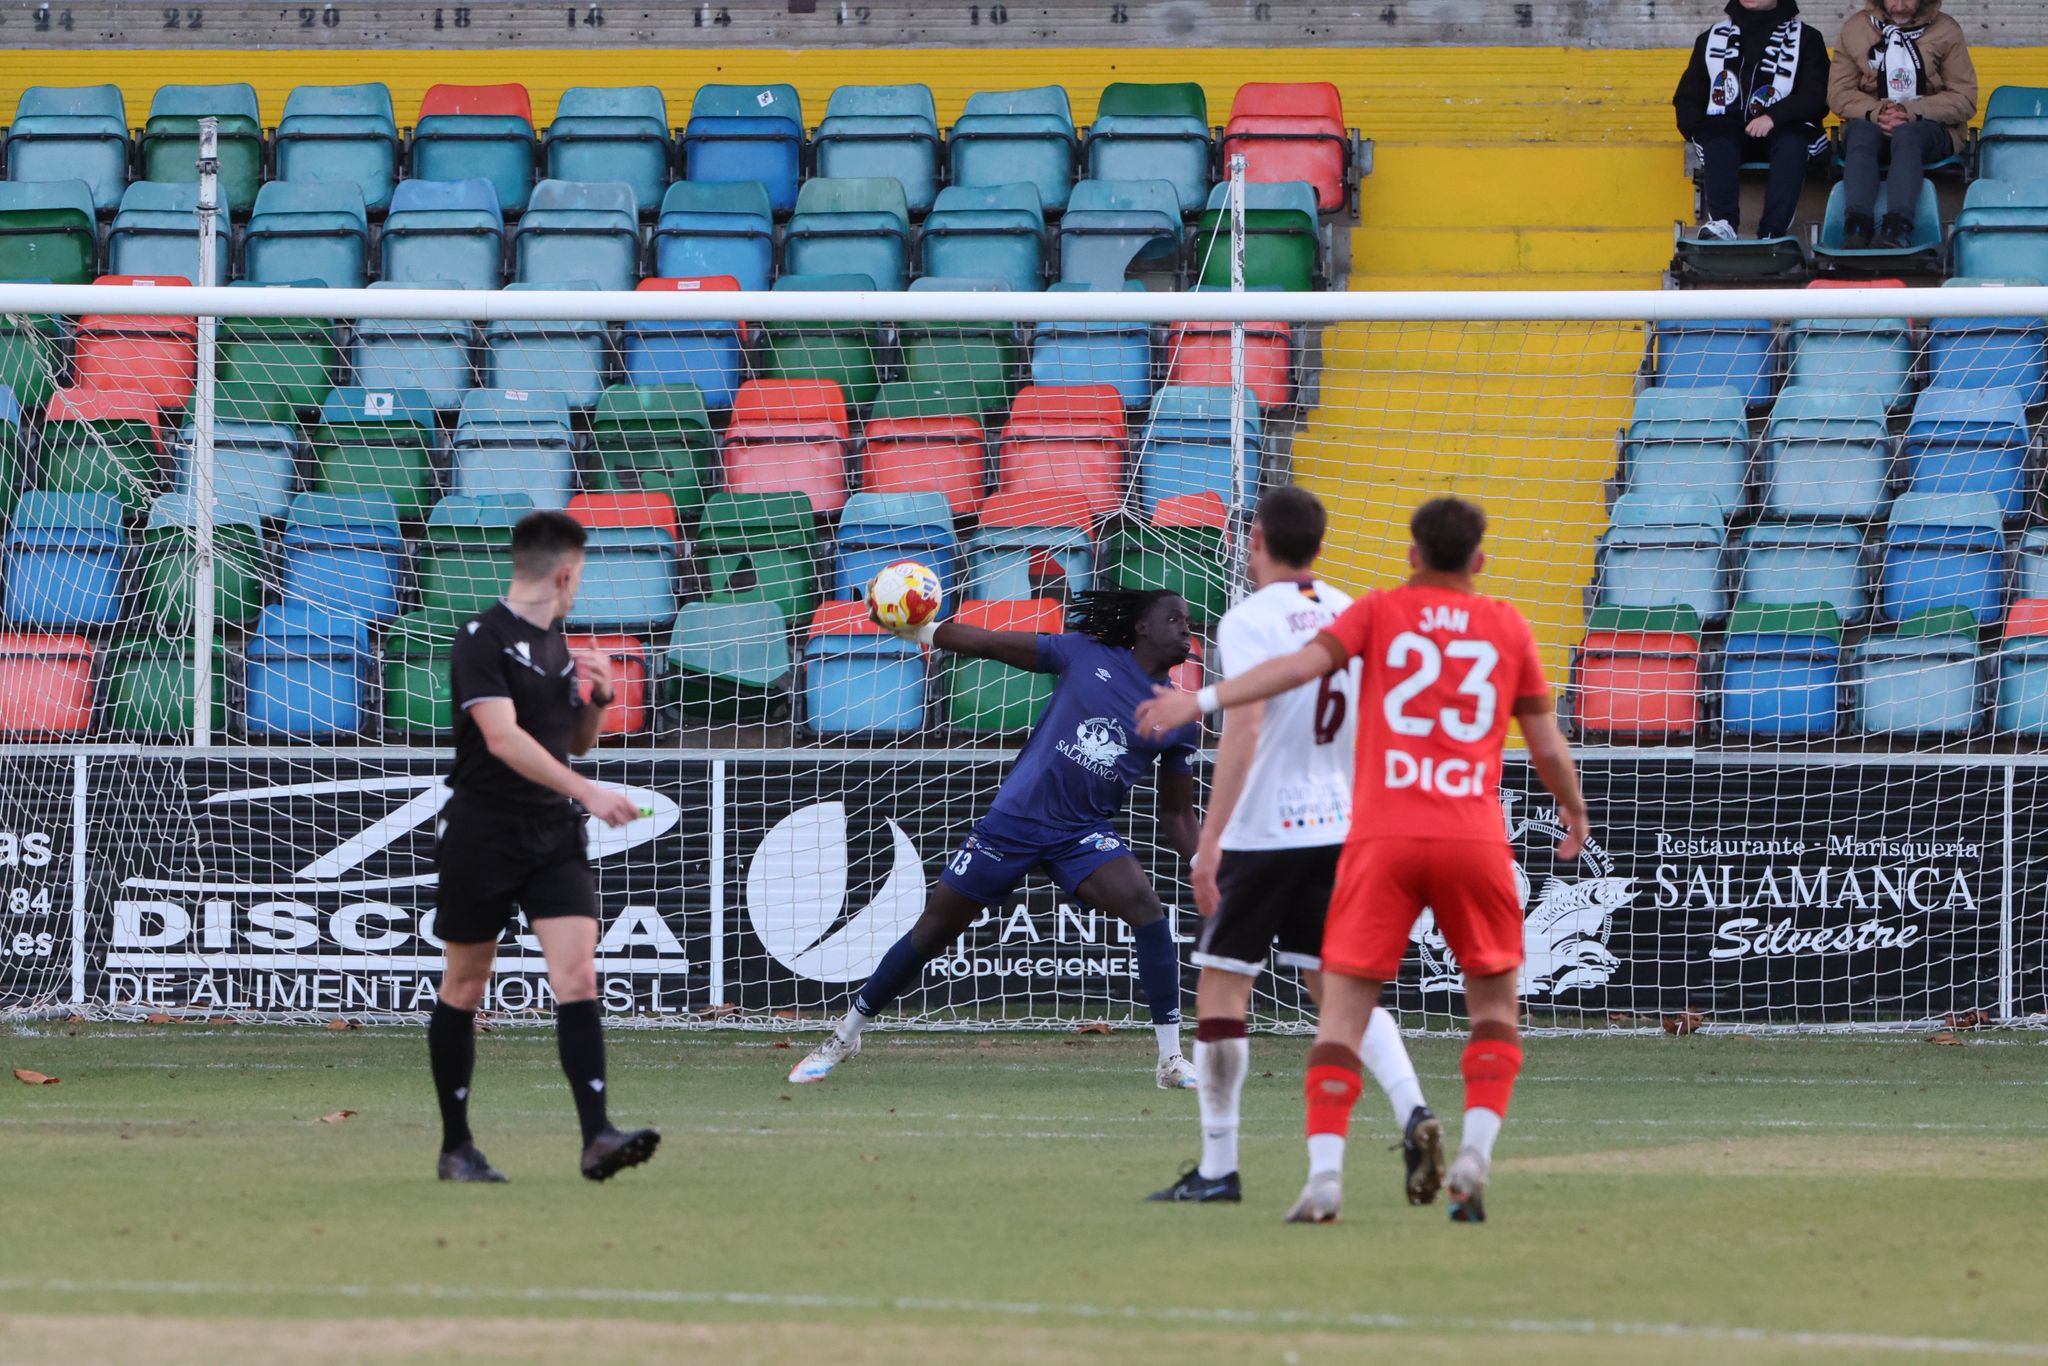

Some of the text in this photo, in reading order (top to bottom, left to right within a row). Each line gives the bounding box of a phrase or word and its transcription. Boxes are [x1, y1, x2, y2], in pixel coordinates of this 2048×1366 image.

[162, 8, 204, 29] 22
[298, 8, 341, 29] 20
[433, 8, 471, 30] 18
[693, 7, 732, 28] 14
[836, 6, 871, 25] 12
[968, 5, 1008, 25] 10
[1109, 2, 1129, 24] 8
[1419, 605, 1470, 634] JAN
[1383, 631, 1499, 743] 23
[1314, 663, 1348, 745] 6
[1055, 739, 1119, 783] SALAMANCA
[1384, 748, 1487, 798] DIGI
[1654, 832, 1806, 856] Restaurante
[1829, 834, 1979, 863] Marisquería
[949, 849, 972, 876] 13
[10, 887, 51, 915] 84
[1653, 863, 1978, 911] SALAMANCA
[113, 900, 687, 954] DISCA
[1708, 916, 1919, 959] Silvestre
[0, 932, 53, 957] .es
[931, 957, 1140, 977] RODUCCIONES
[109, 973, 176, 1008] DE
[602, 978, 689, 1012] S.L.
